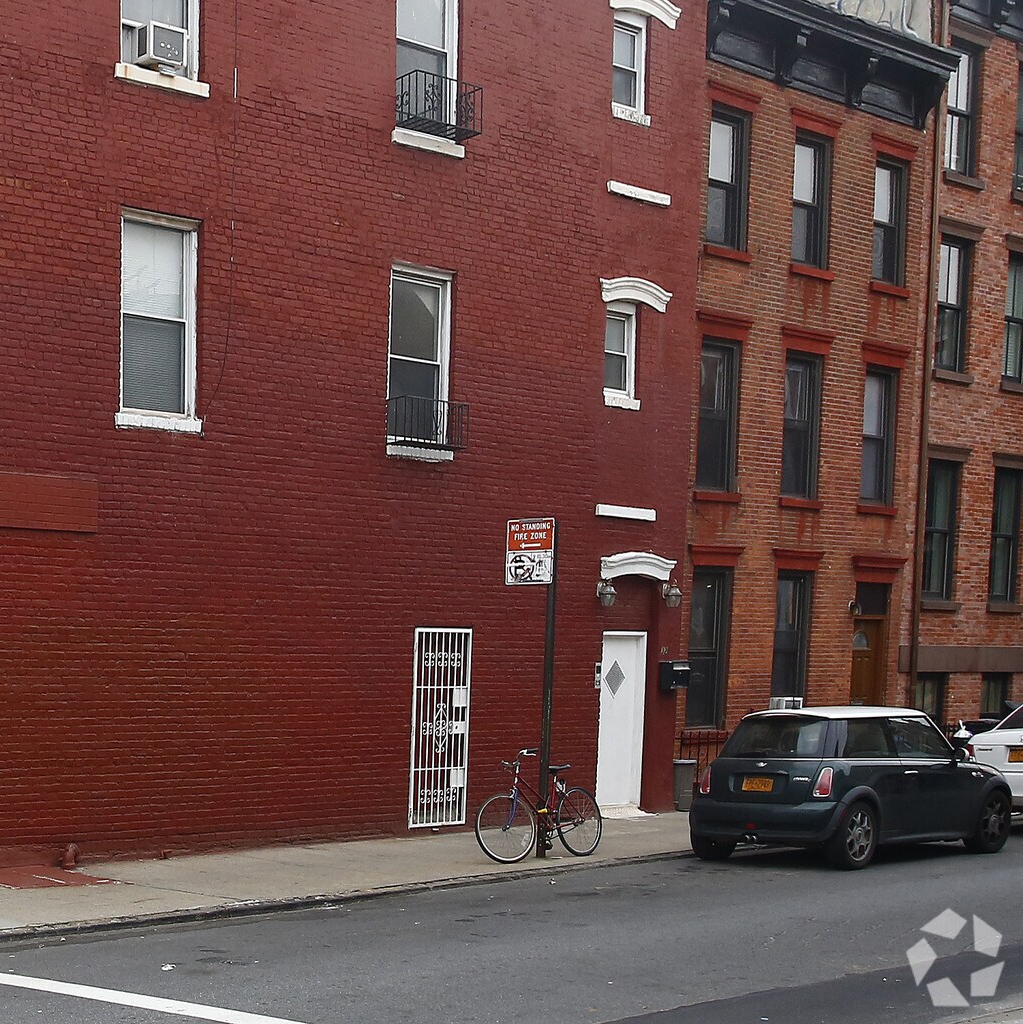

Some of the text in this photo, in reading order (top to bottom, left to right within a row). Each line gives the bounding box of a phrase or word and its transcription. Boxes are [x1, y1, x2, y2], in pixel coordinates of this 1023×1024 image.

[510, 522, 551, 532] NO STANDING
[514, 531, 547, 541] FIRE ZONE
